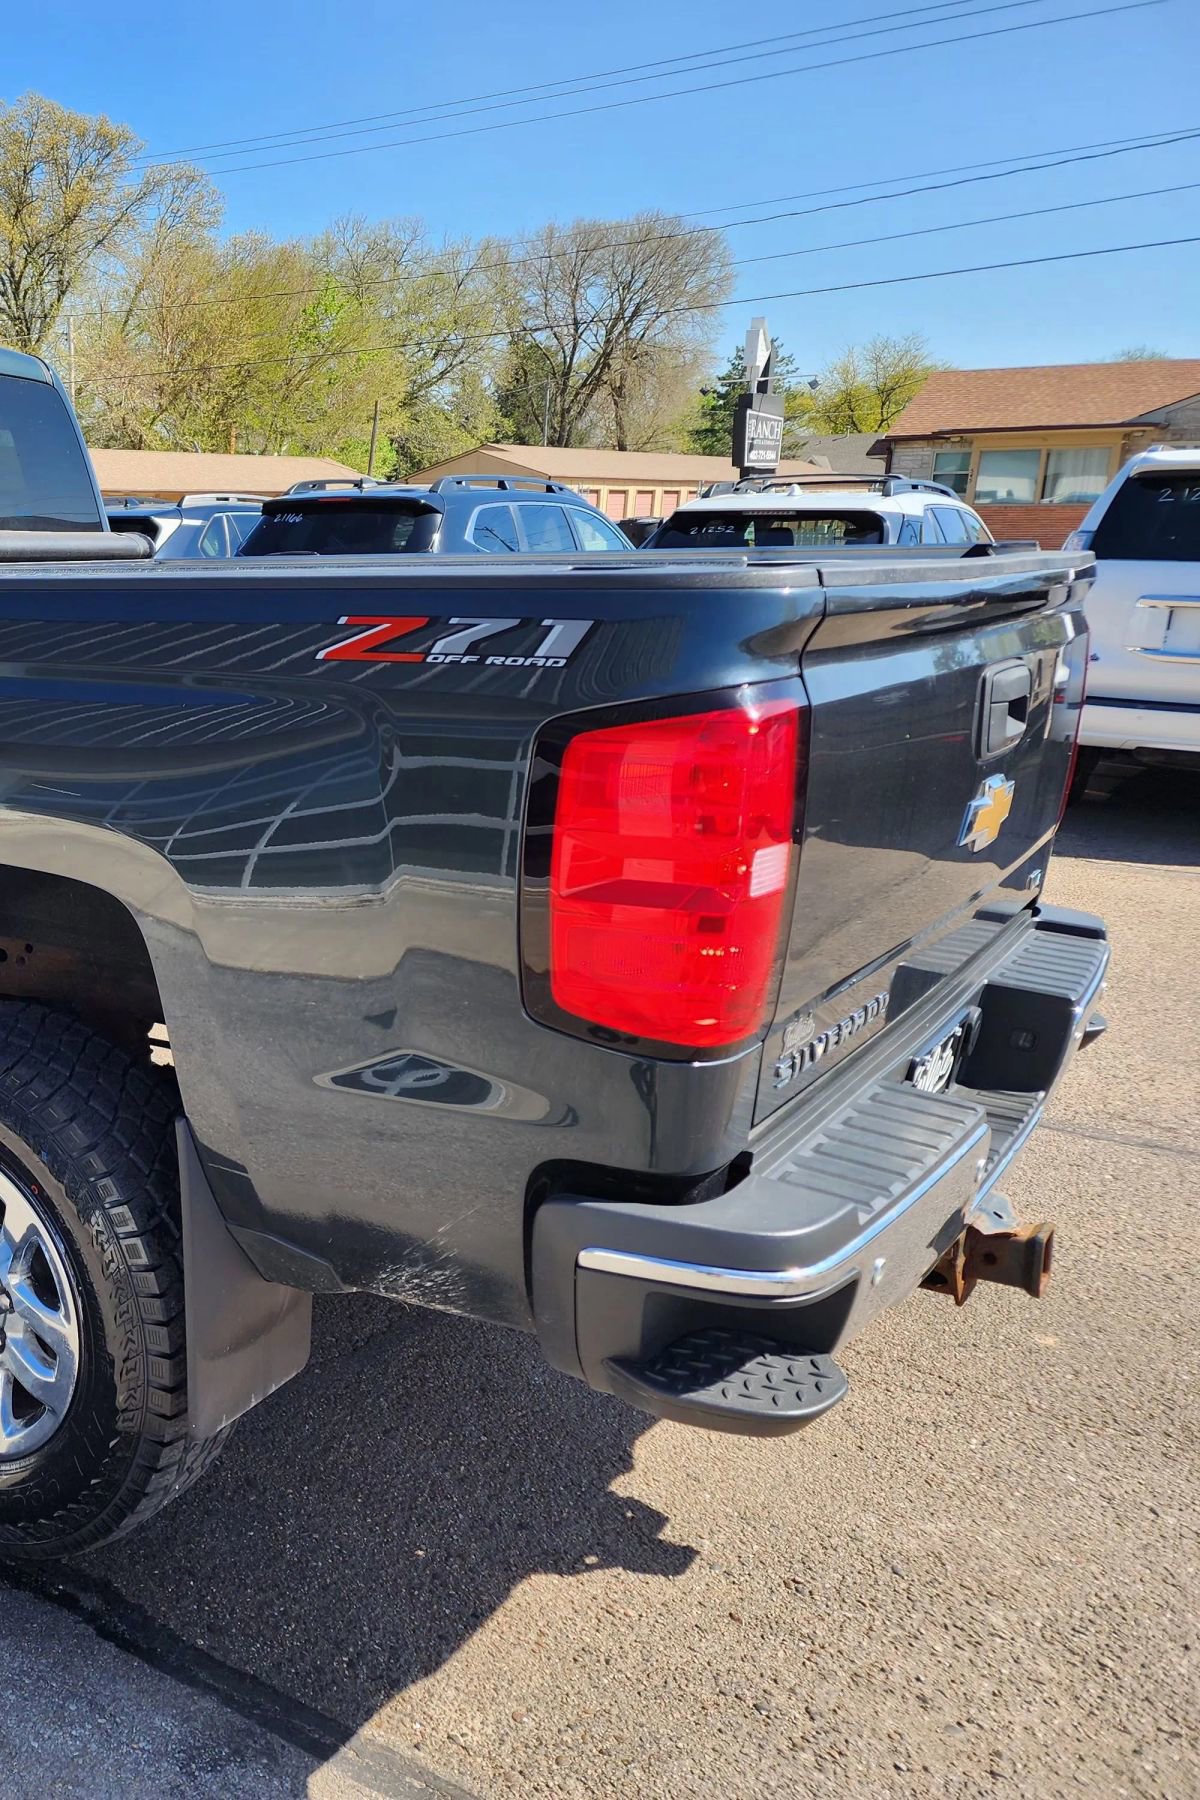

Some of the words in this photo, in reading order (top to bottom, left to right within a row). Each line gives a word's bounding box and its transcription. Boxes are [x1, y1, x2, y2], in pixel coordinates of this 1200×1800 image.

[750, 419, 781, 439] RANCH
[689, 525, 736, 535] 21252
[315, 616, 594, 662] Z71
[425, 655, 480, 664] OFF
[486, 656, 568, 667] ROAD
[773, 991, 890, 1088] SILVERADO
